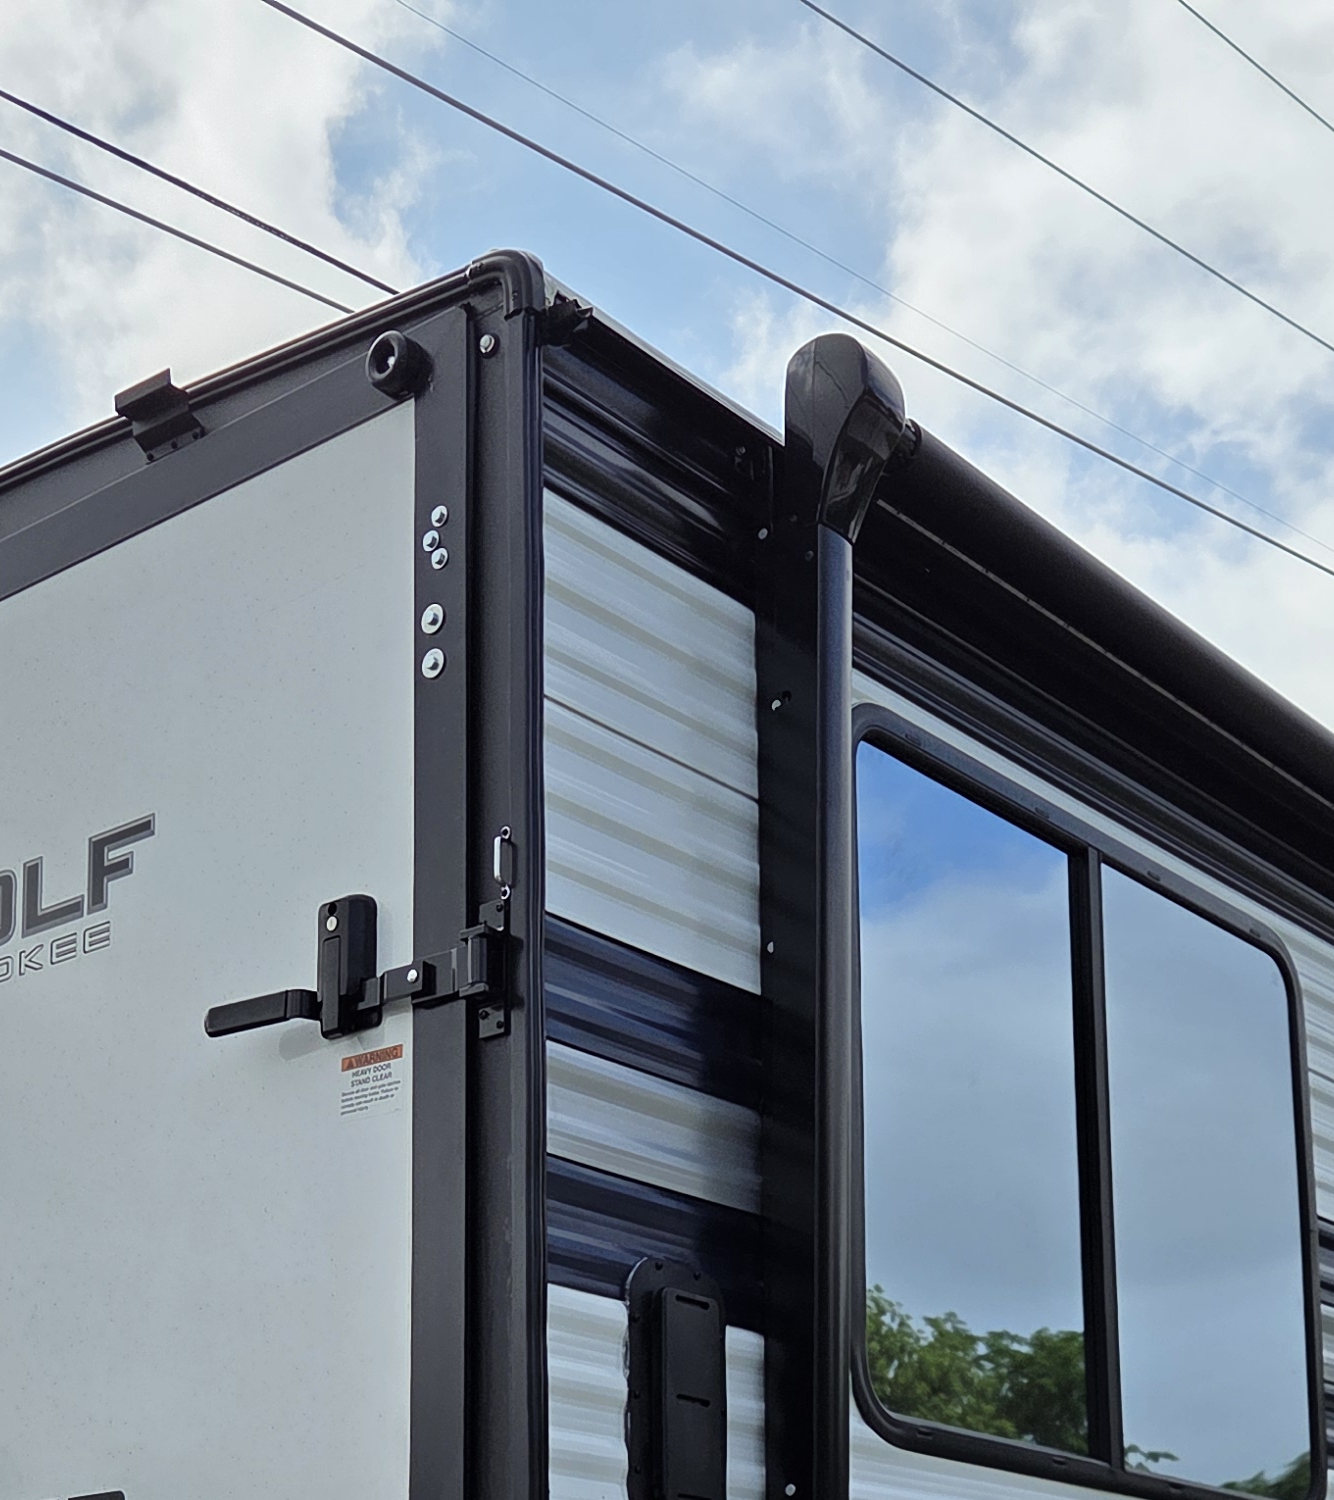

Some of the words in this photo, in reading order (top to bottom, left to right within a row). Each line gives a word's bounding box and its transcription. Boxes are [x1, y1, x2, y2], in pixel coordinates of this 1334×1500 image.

[355, 1047, 399, 1065] WARNING
[351, 1067, 372, 1078] HEAVY
[373, 1062, 392, 1074] DOOR
[350, 1076, 371, 1088] STAND
[372, 1071, 393, 1083] CLEAR
